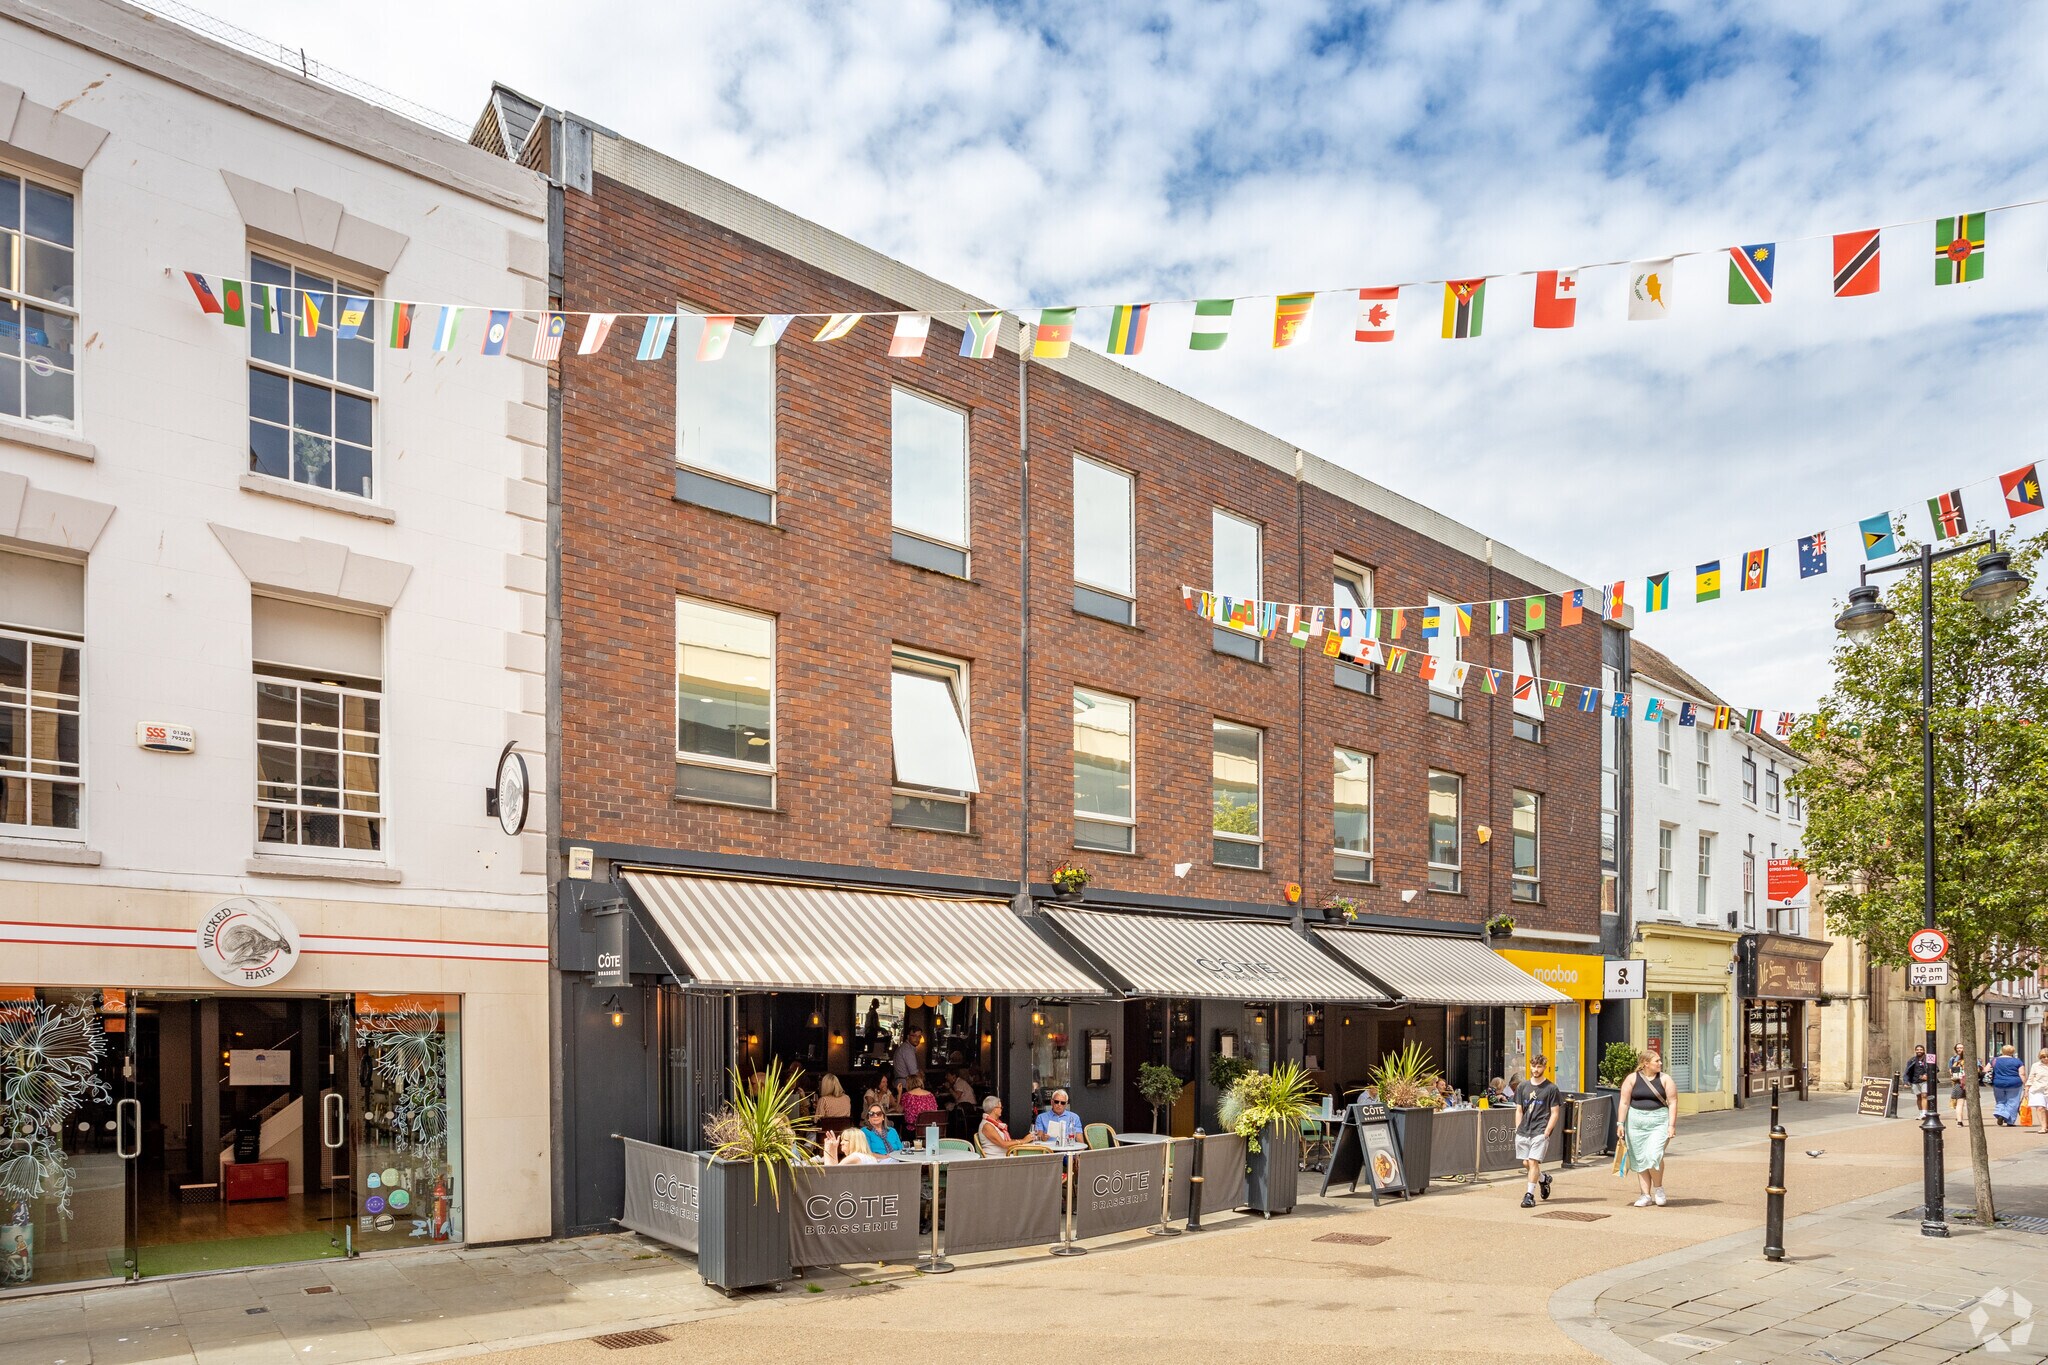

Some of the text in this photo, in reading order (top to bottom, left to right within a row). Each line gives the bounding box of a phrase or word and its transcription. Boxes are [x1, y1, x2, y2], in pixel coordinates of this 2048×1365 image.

[146, 726, 167, 738] SSS
[203, 907, 232, 949] WICKED
[598, 952, 621, 968] CÔTE
[1796, 961, 1808, 976] Olde
[245, 966, 275, 980] HAIR
[1533, 964, 1578, 983] mooboo
[1758, 962, 1769, 991] Mr
[1786, 975, 1817, 994] Sweet Shoppe
[1362, 1105, 1385, 1116] CÔTE
[653, 1172, 699, 1209] CÔTE
[1092, 1169, 1150, 1198] CÔTE
[805, 1190, 899, 1222] CÔTE
[1091, 1193, 1148, 1211] BRASSERIE
[804, 1220, 899, 1236] BRASSERIE
